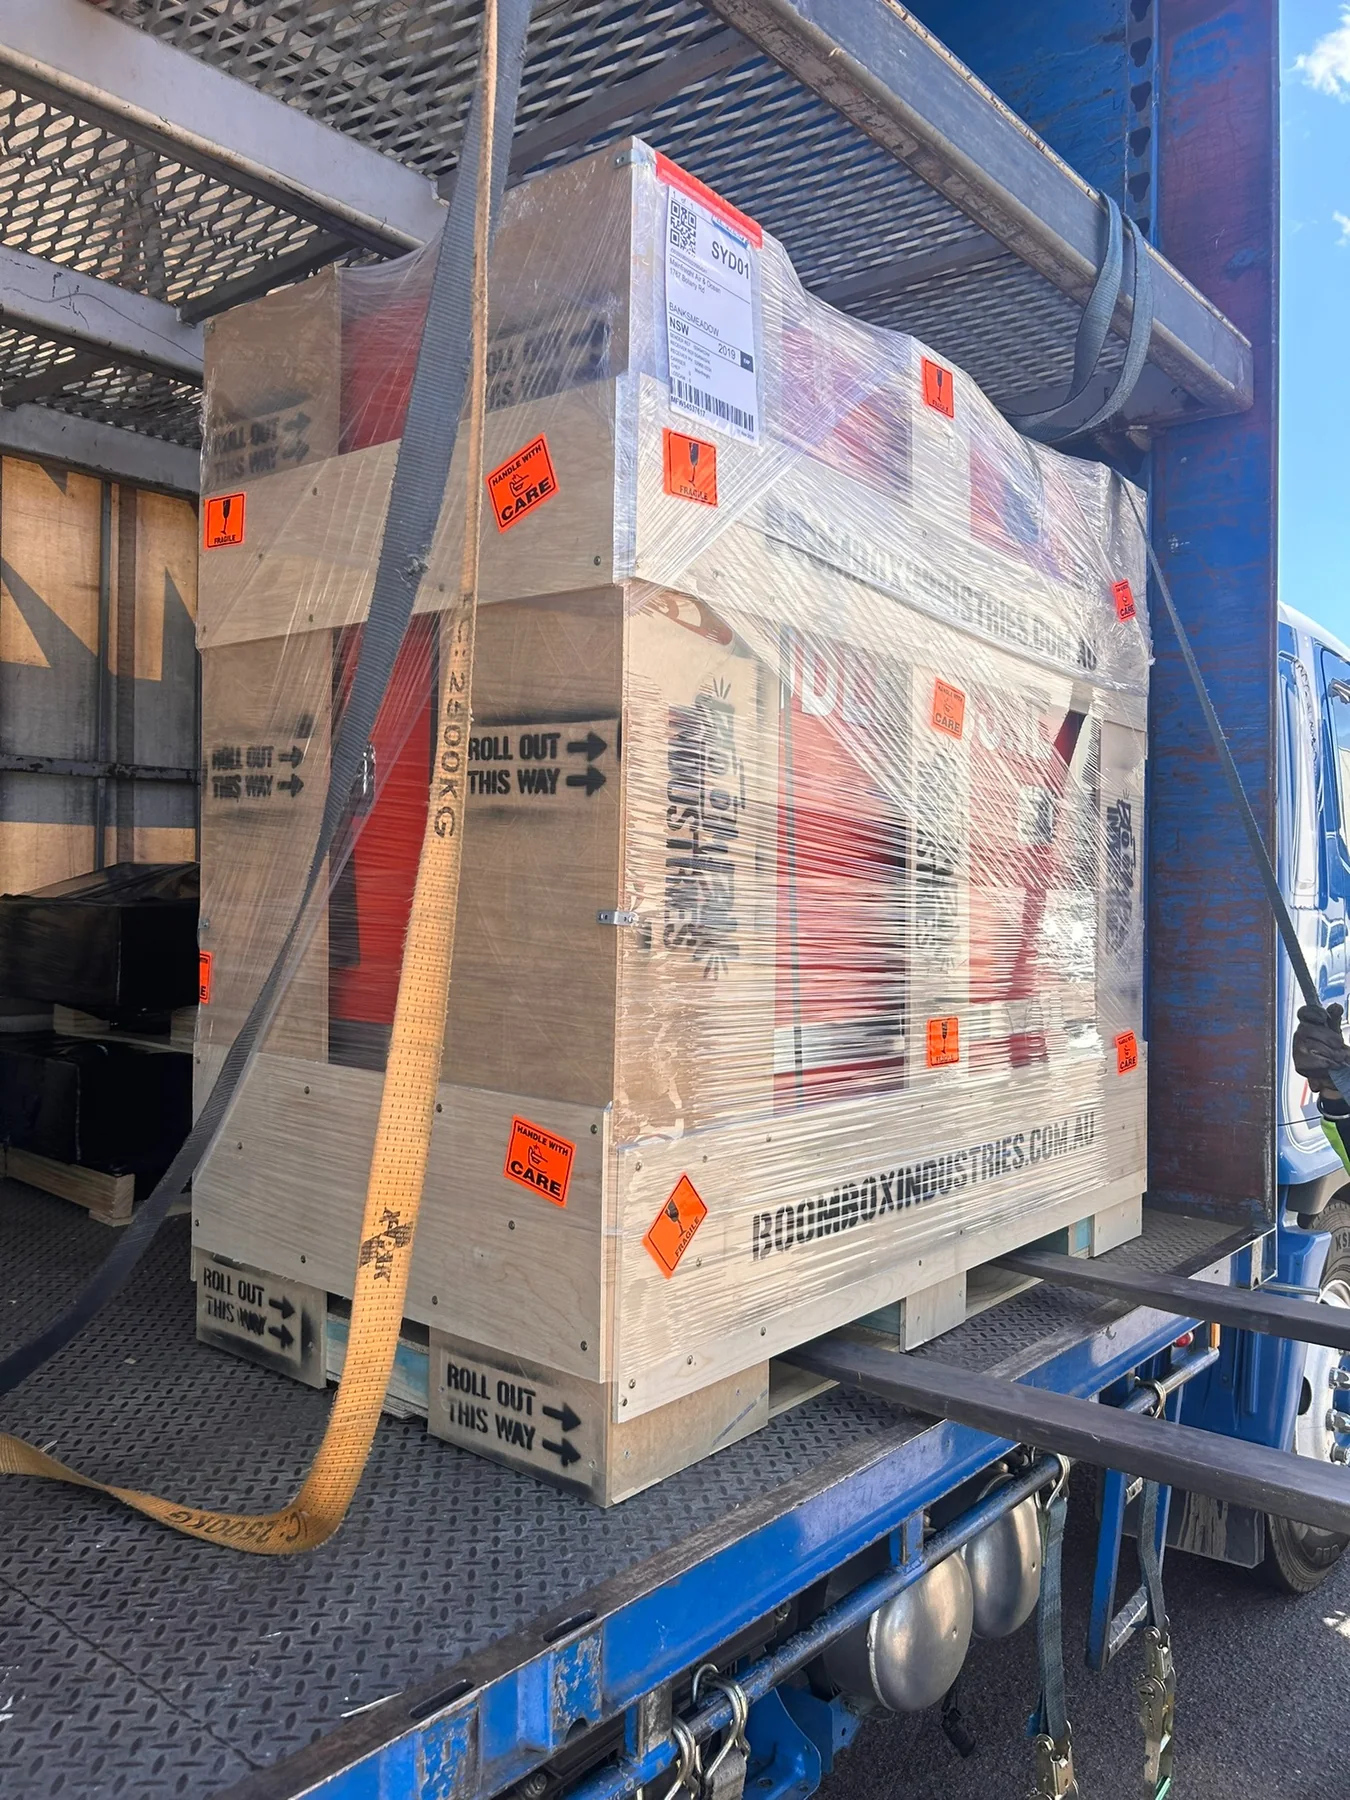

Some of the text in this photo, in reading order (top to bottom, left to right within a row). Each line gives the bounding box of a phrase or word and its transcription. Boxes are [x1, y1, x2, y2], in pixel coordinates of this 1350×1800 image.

[711, 241, 749, 280] SYD01
[669, 301, 719, 337] BANKSMEADOW
[669, 316, 690, 336] NSW
[718, 343, 736, 360] 2019
[491, 443, 542, 487] HANDLE WITH
[501, 476, 552, 521] CARE
[679, 484, 708, 501] FRAGILE
[213, 534, 236, 545] FRAGILE
[934, 711, 961, 734] CARE
[468, 732, 562, 761] ROLL OUT
[467, 767, 561, 796] THIS WAY
[1119, 1055, 1137, 1069] CARE
[516, 1124, 569, 1157] HANDLE WITH
[510, 1160, 562, 1198] CARE
[752, 1110, 1095, 1261] BOOMBOXINDUSTRIES.COM.AU
[674, 1215, 701, 1257] FRAGILE
[203, 1266, 265, 1308] ROLL OUT
[205, 1294, 235, 1323] THIS
[447, 1363, 537, 1417] ROLL OUT
[449, 1396, 537, 1452] THIS WAY
